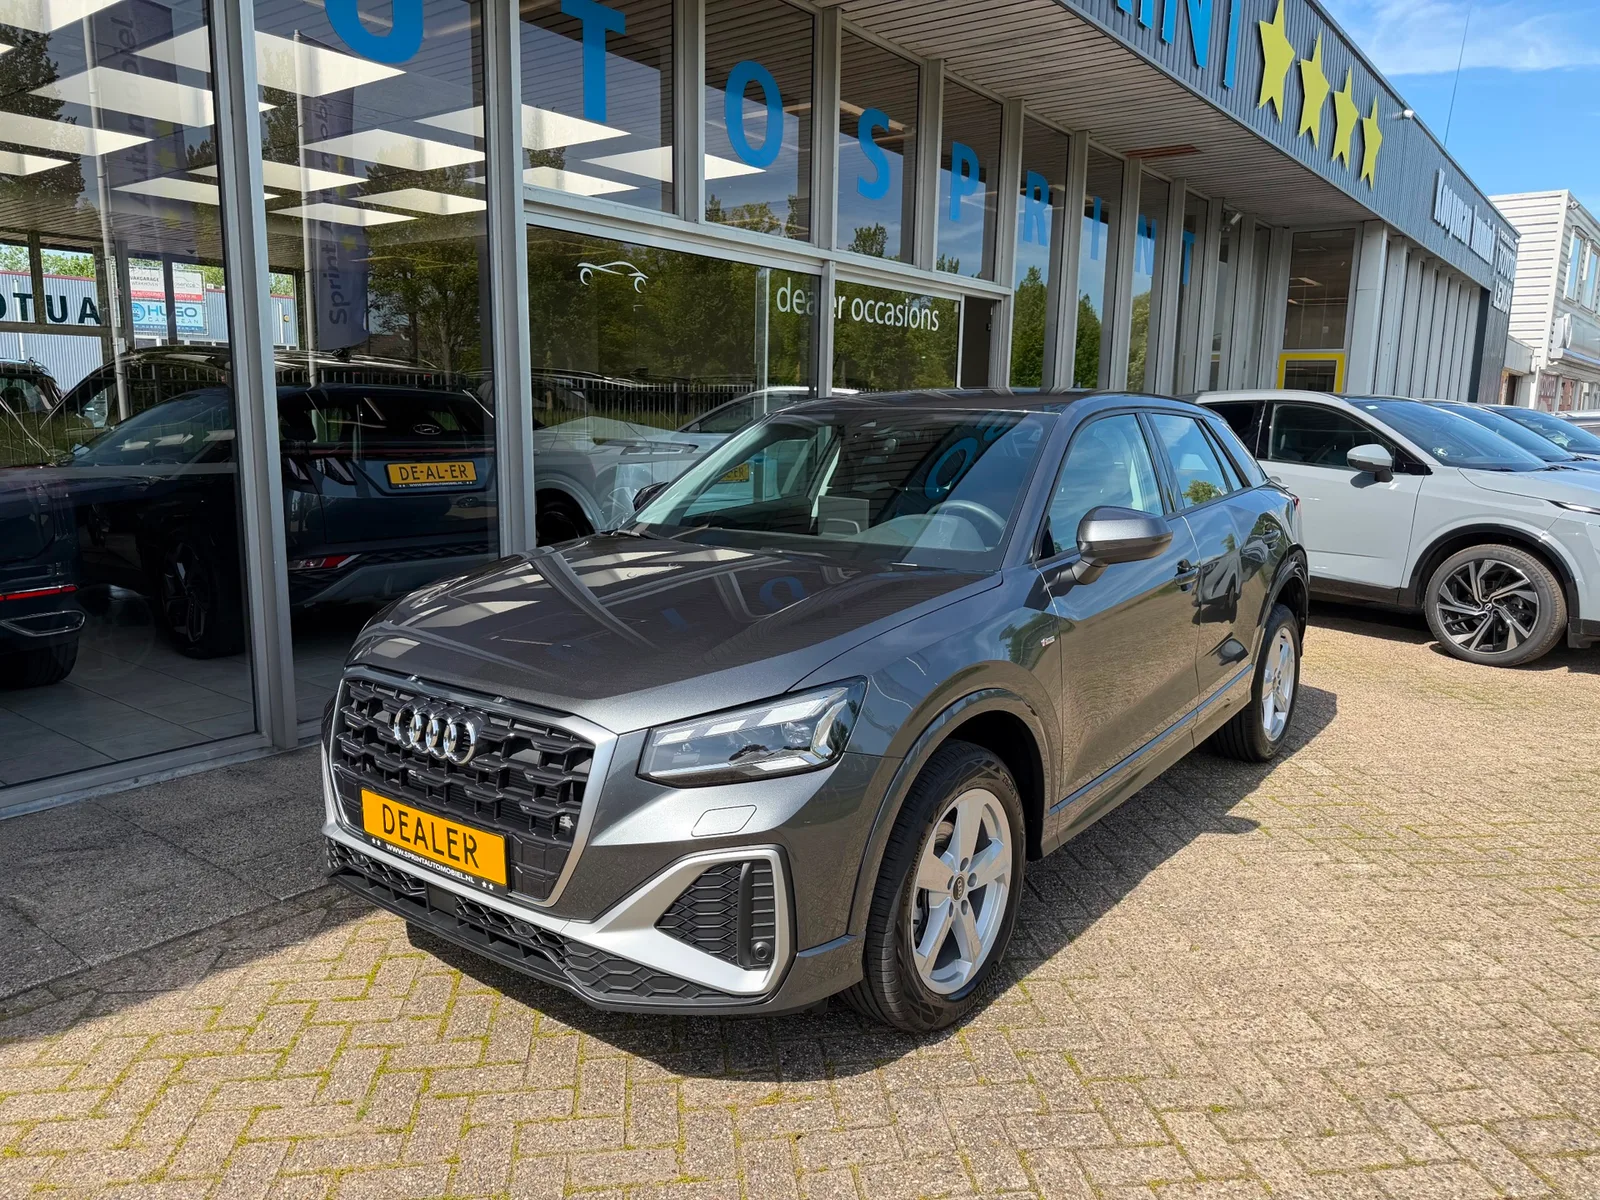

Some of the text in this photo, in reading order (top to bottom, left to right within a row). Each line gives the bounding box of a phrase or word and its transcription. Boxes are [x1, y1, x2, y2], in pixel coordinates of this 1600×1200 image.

[147, 304, 198, 318] HUGO
[321, 244, 351, 325] Sprint
[776, 276, 939, 332] dear occasions
[399, 464, 468, 481] DE-AL-ER
[382, 804, 480, 869] DEALER
